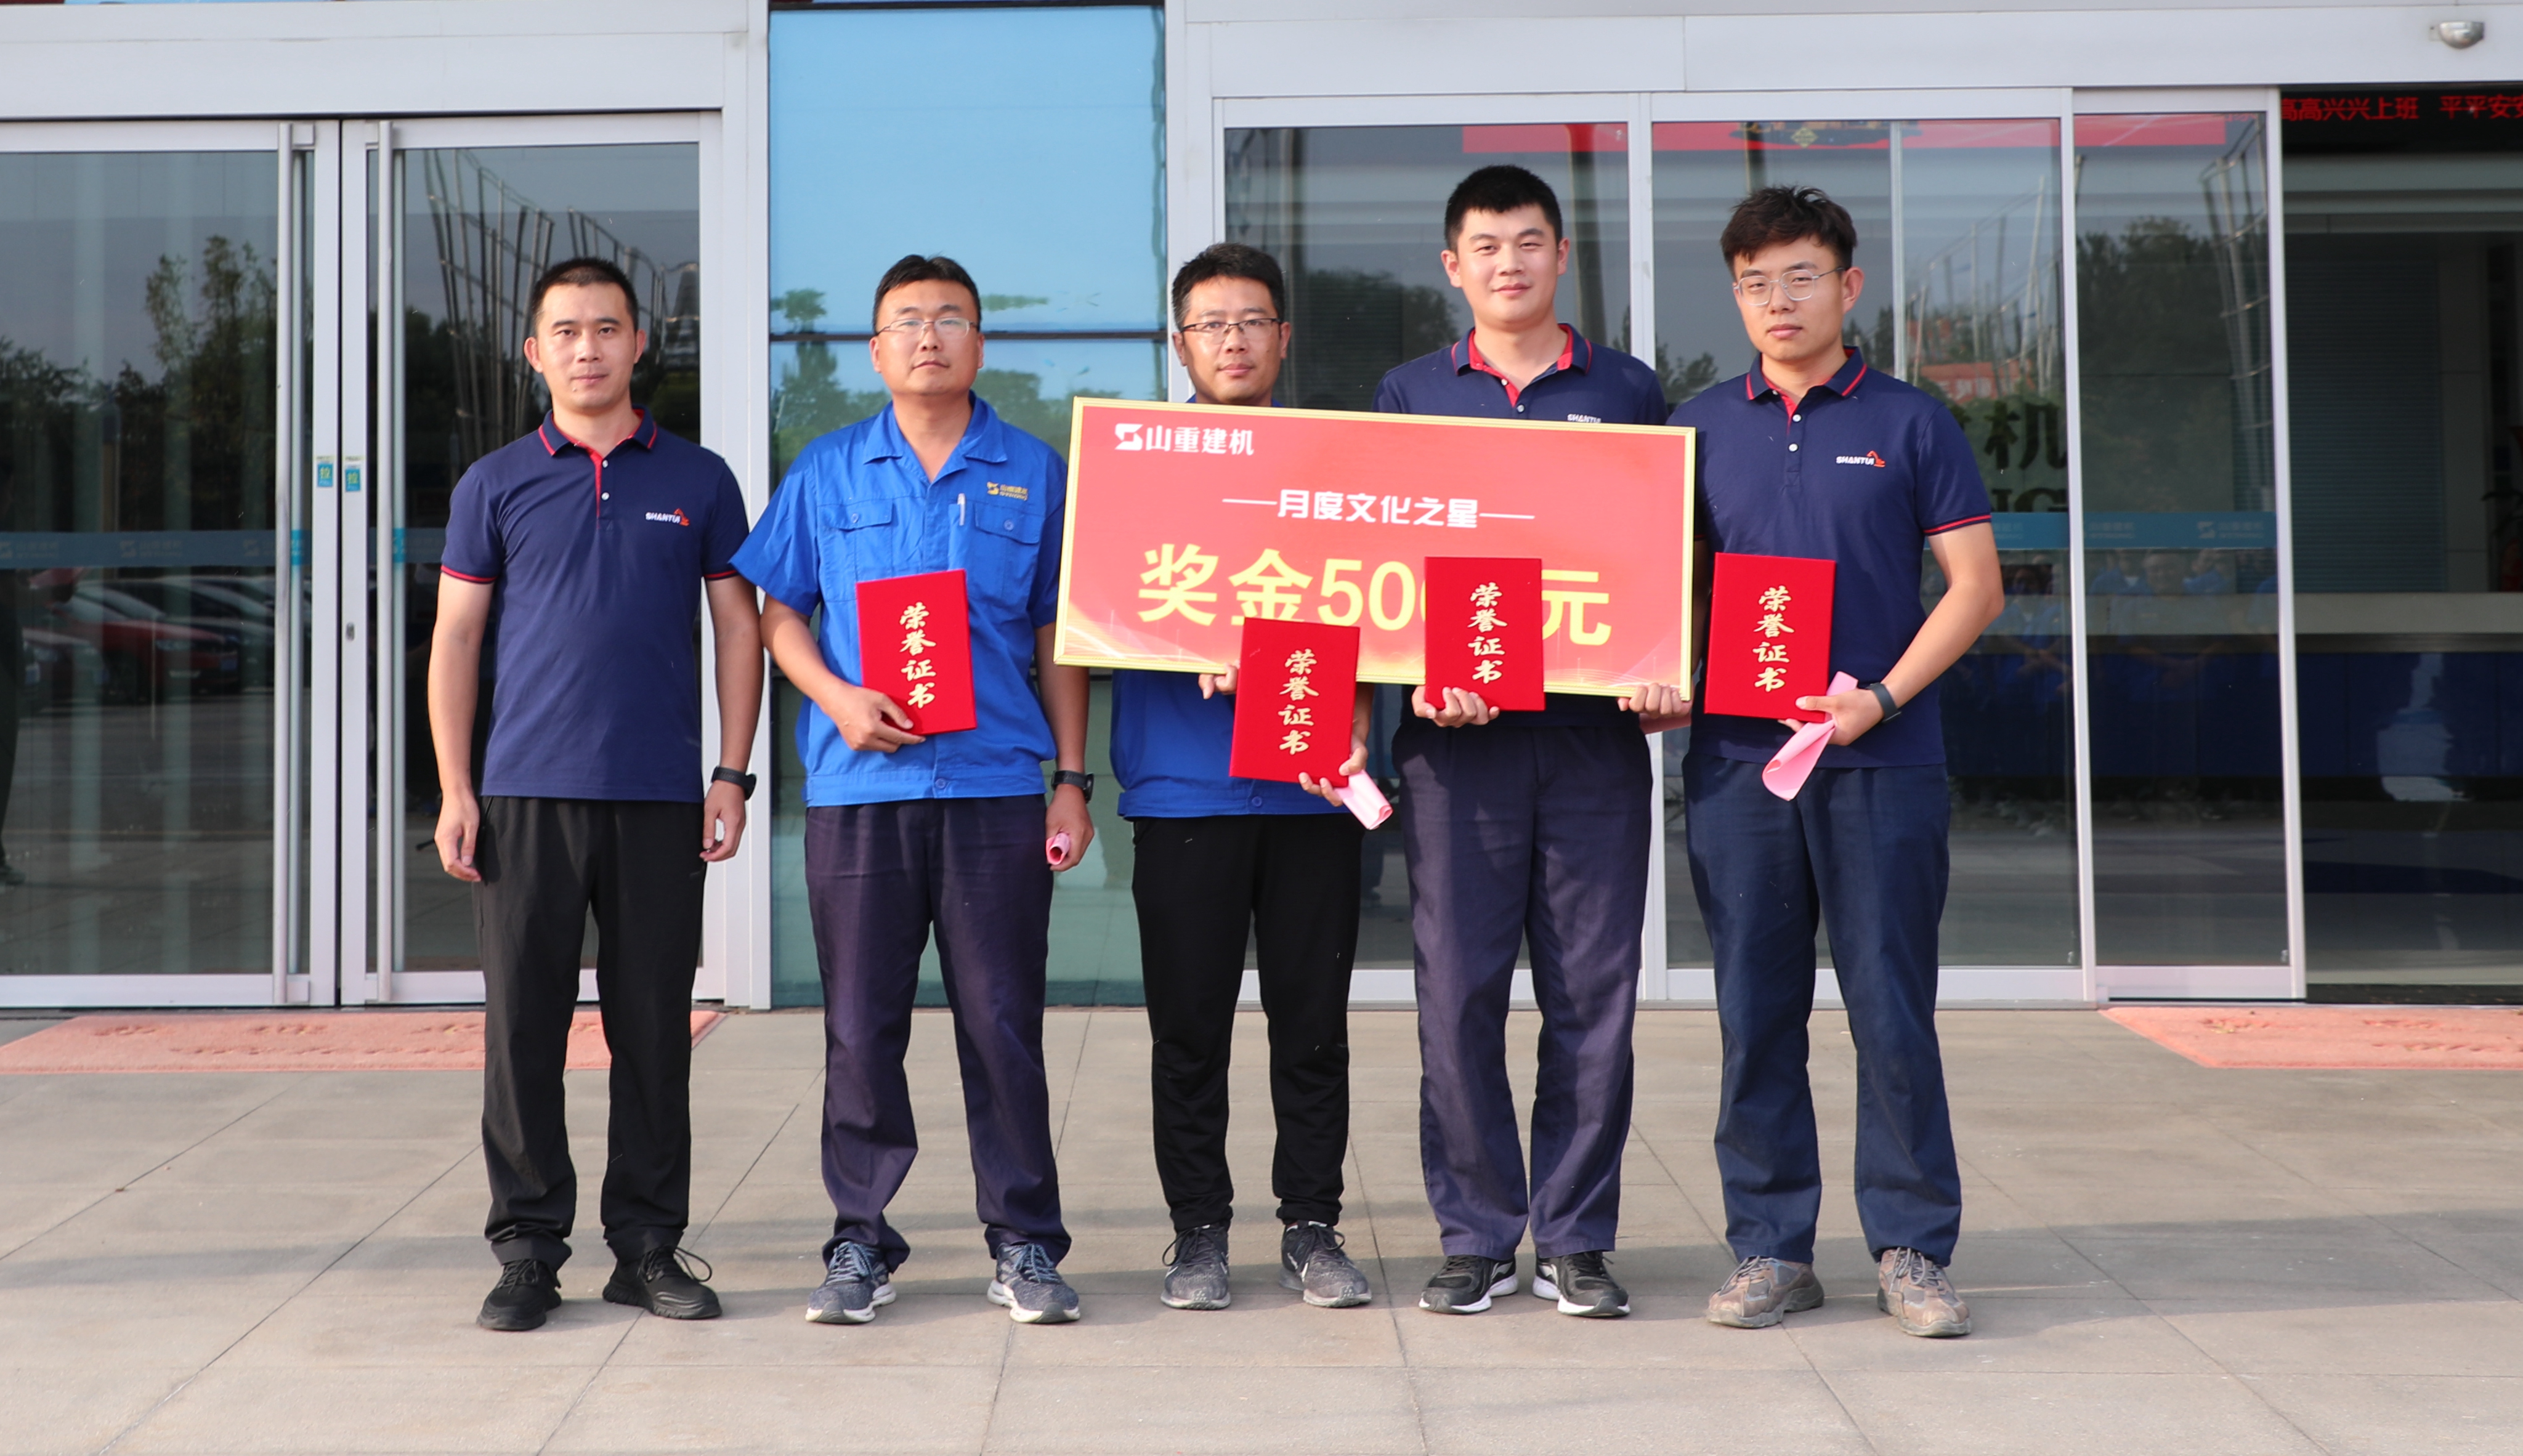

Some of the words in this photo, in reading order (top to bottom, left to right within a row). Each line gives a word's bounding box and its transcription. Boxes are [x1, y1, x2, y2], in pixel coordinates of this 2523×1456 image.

[2282, 97, 2420, 121] 高高兴兴上班
[1146, 425, 1254, 456] 山重建机
[1836, 456, 1875, 466] SHANTUI
[1950, 402, 2068, 470] 机
[645, 512, 681, 524] SHANTUI
[1138, 543, 1612, 646] 奖金50元
[1467, 582, 1508, 684] 荣誉证书
[899, 601, 937, 709] 荣誉证书
[1752, 585, 1794, 692] 荣誉证书
[1278, 649, 1319, 755] 荣誉证书
